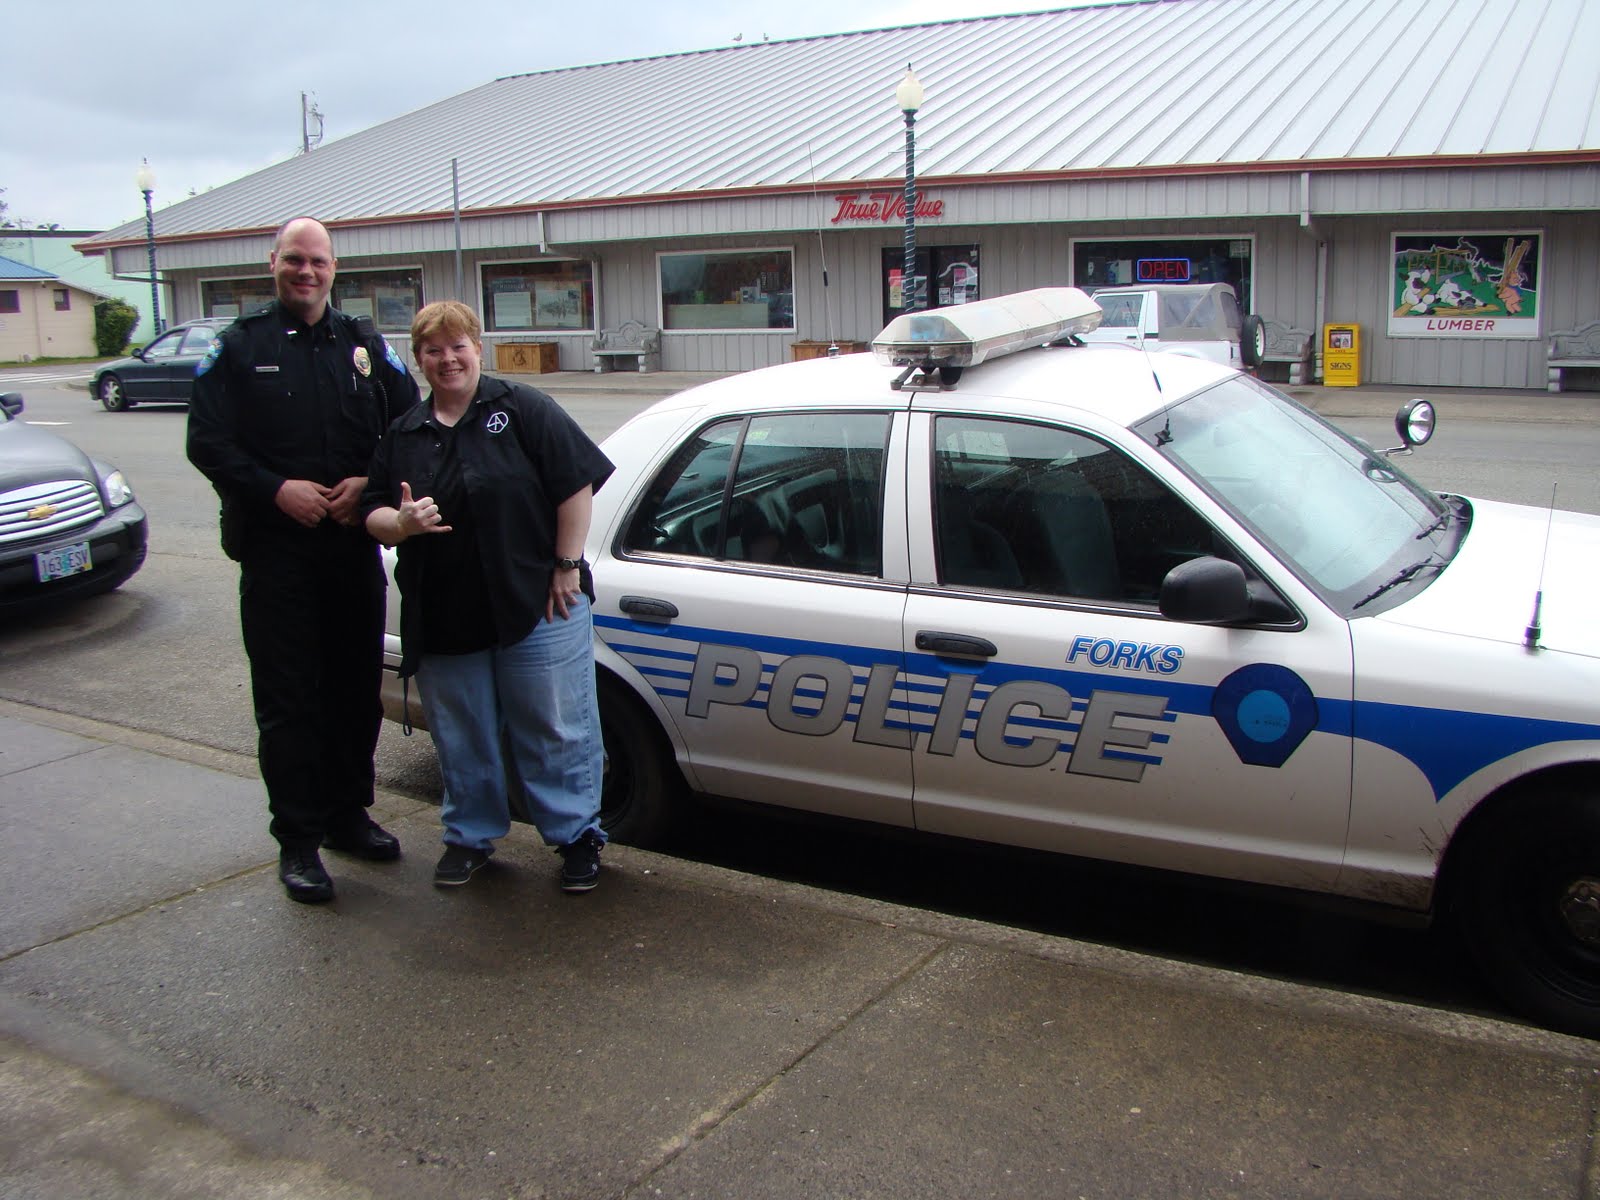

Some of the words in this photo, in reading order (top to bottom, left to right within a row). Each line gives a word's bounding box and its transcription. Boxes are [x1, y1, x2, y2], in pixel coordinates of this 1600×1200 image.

[831, 193, 880, 224] True
[869, 191, 944, 223] Value
[1139, 261, 1189, 279] OPEN
[1426, 319, 1495, 331] LUMBER
[1065, 634, 1185, 676] FORKS
[684, 641, 1170, 784] POLICE
